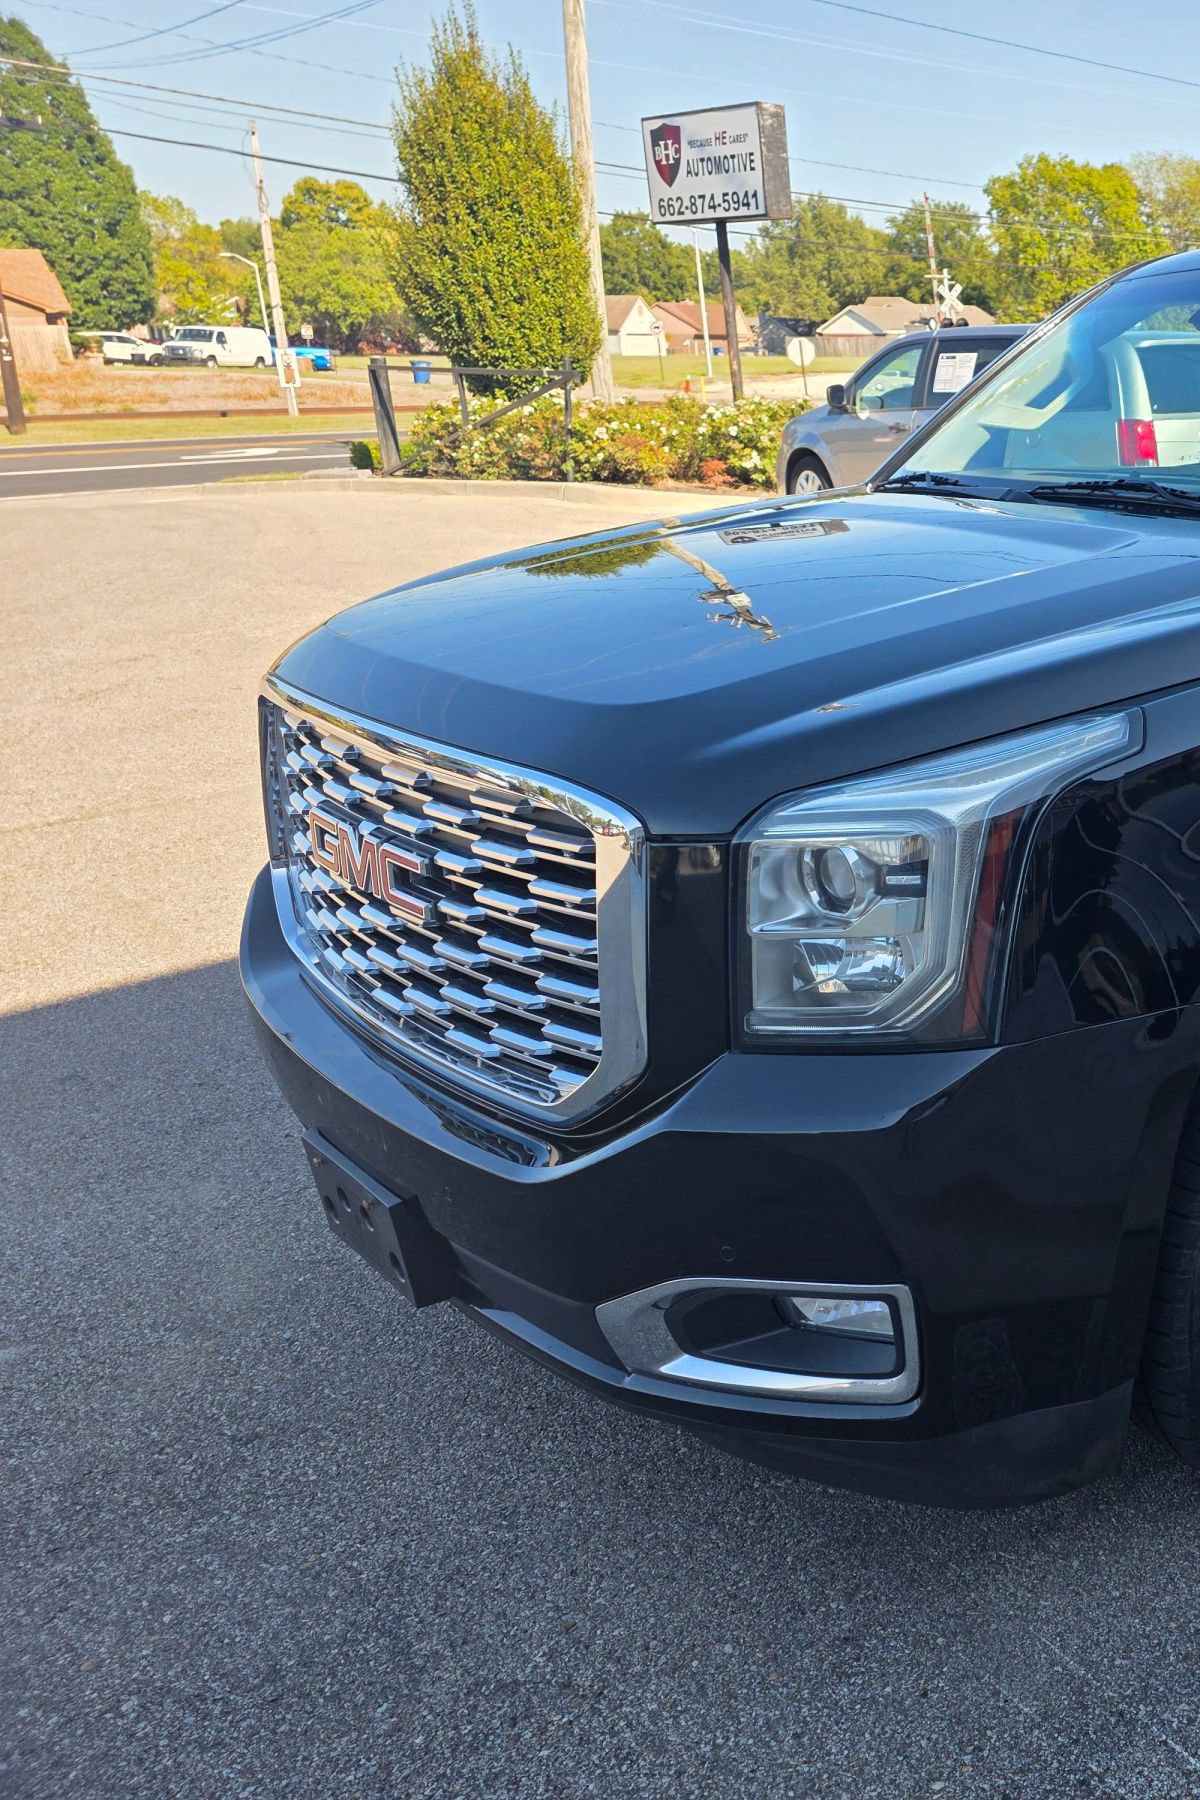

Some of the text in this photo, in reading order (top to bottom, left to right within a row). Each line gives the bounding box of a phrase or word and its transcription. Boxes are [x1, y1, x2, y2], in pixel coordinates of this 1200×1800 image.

[714, 130, 727, 147] HE
[655, 139, 680, 165] BHC
[686, 152, 756, 178] AUTOMOTIVE
[658, 189, 760, 218] 662-874-5941
[309, 806, 431, 922] GMC
